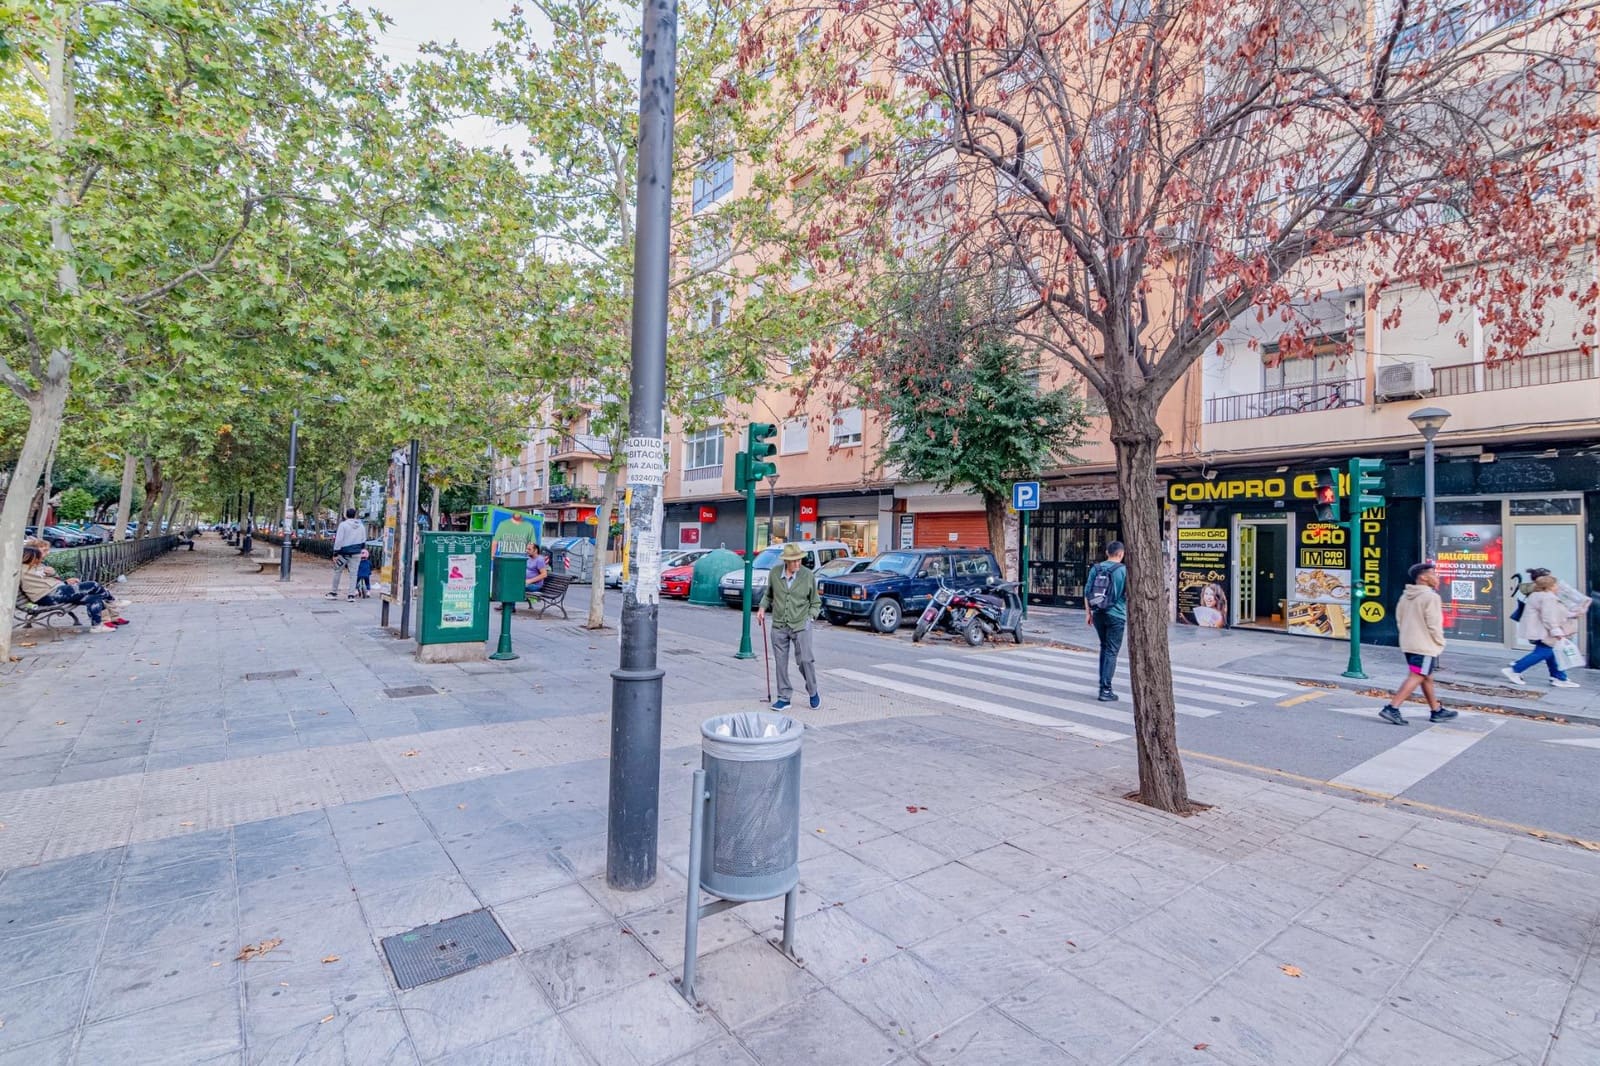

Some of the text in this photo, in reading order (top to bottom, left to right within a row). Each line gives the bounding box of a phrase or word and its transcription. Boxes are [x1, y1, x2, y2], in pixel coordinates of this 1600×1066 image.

[1170, 478, 1286, 501] COMPRO
[1018, 486, 1033, 507] P
[1207, 530, 1226, 538] ORO
[1302, 530, 1345, 544] ORO
[497, 541, 527, 553] PREND
[1324, 551, 1343, 559] ORO
[1364, 522, 1381, 597] DINERO
[1438, 552, 1489, 561] HALLOWEEN
[1363, 606, 1381, 617] YA
